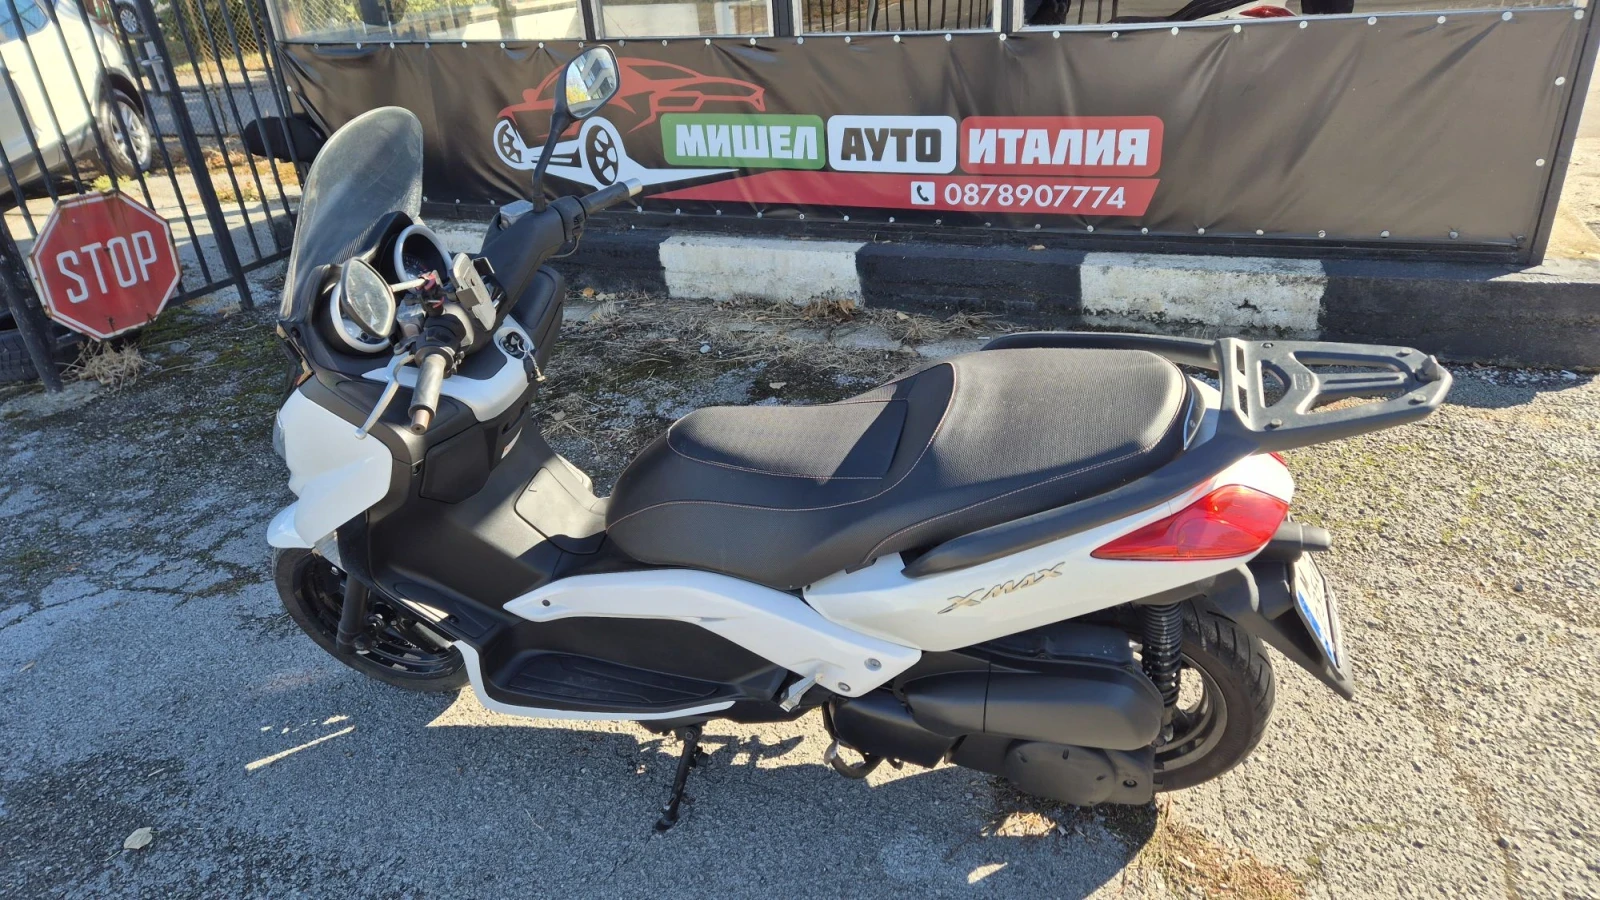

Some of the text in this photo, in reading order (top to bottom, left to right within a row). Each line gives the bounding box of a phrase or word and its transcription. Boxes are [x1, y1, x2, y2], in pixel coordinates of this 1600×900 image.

[676, 124, 1150, 166] МИШЕЛ АУТО ИТАЛИЯ
[944, 183, 1126, 209] 0878907774
[56, 230, 157, 303] STOP
